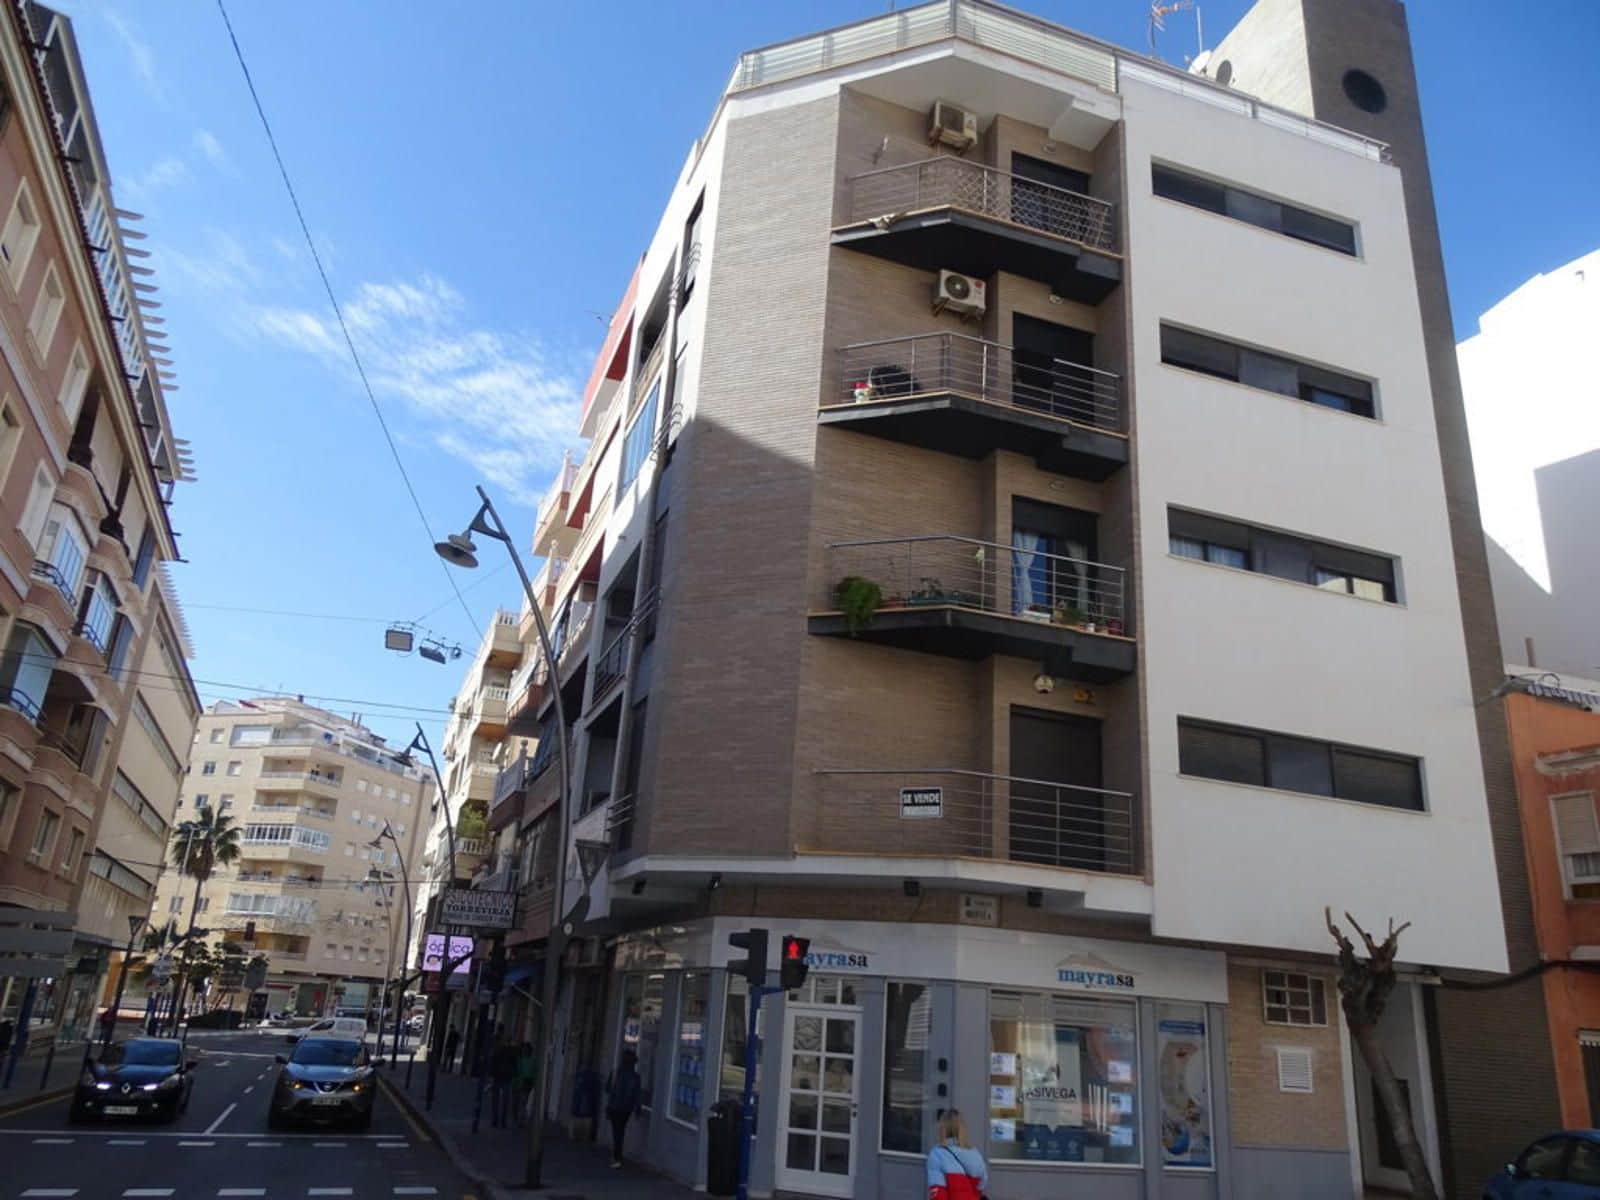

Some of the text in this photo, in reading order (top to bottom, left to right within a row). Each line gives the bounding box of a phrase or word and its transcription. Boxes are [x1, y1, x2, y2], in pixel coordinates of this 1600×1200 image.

[903, 792, 940, 804] SE VENDE
[428, 940, 471, 954] ópica
[805, 951, 869, 970] ayrasa
[1057, 969, 1135, 989] mayrasa
